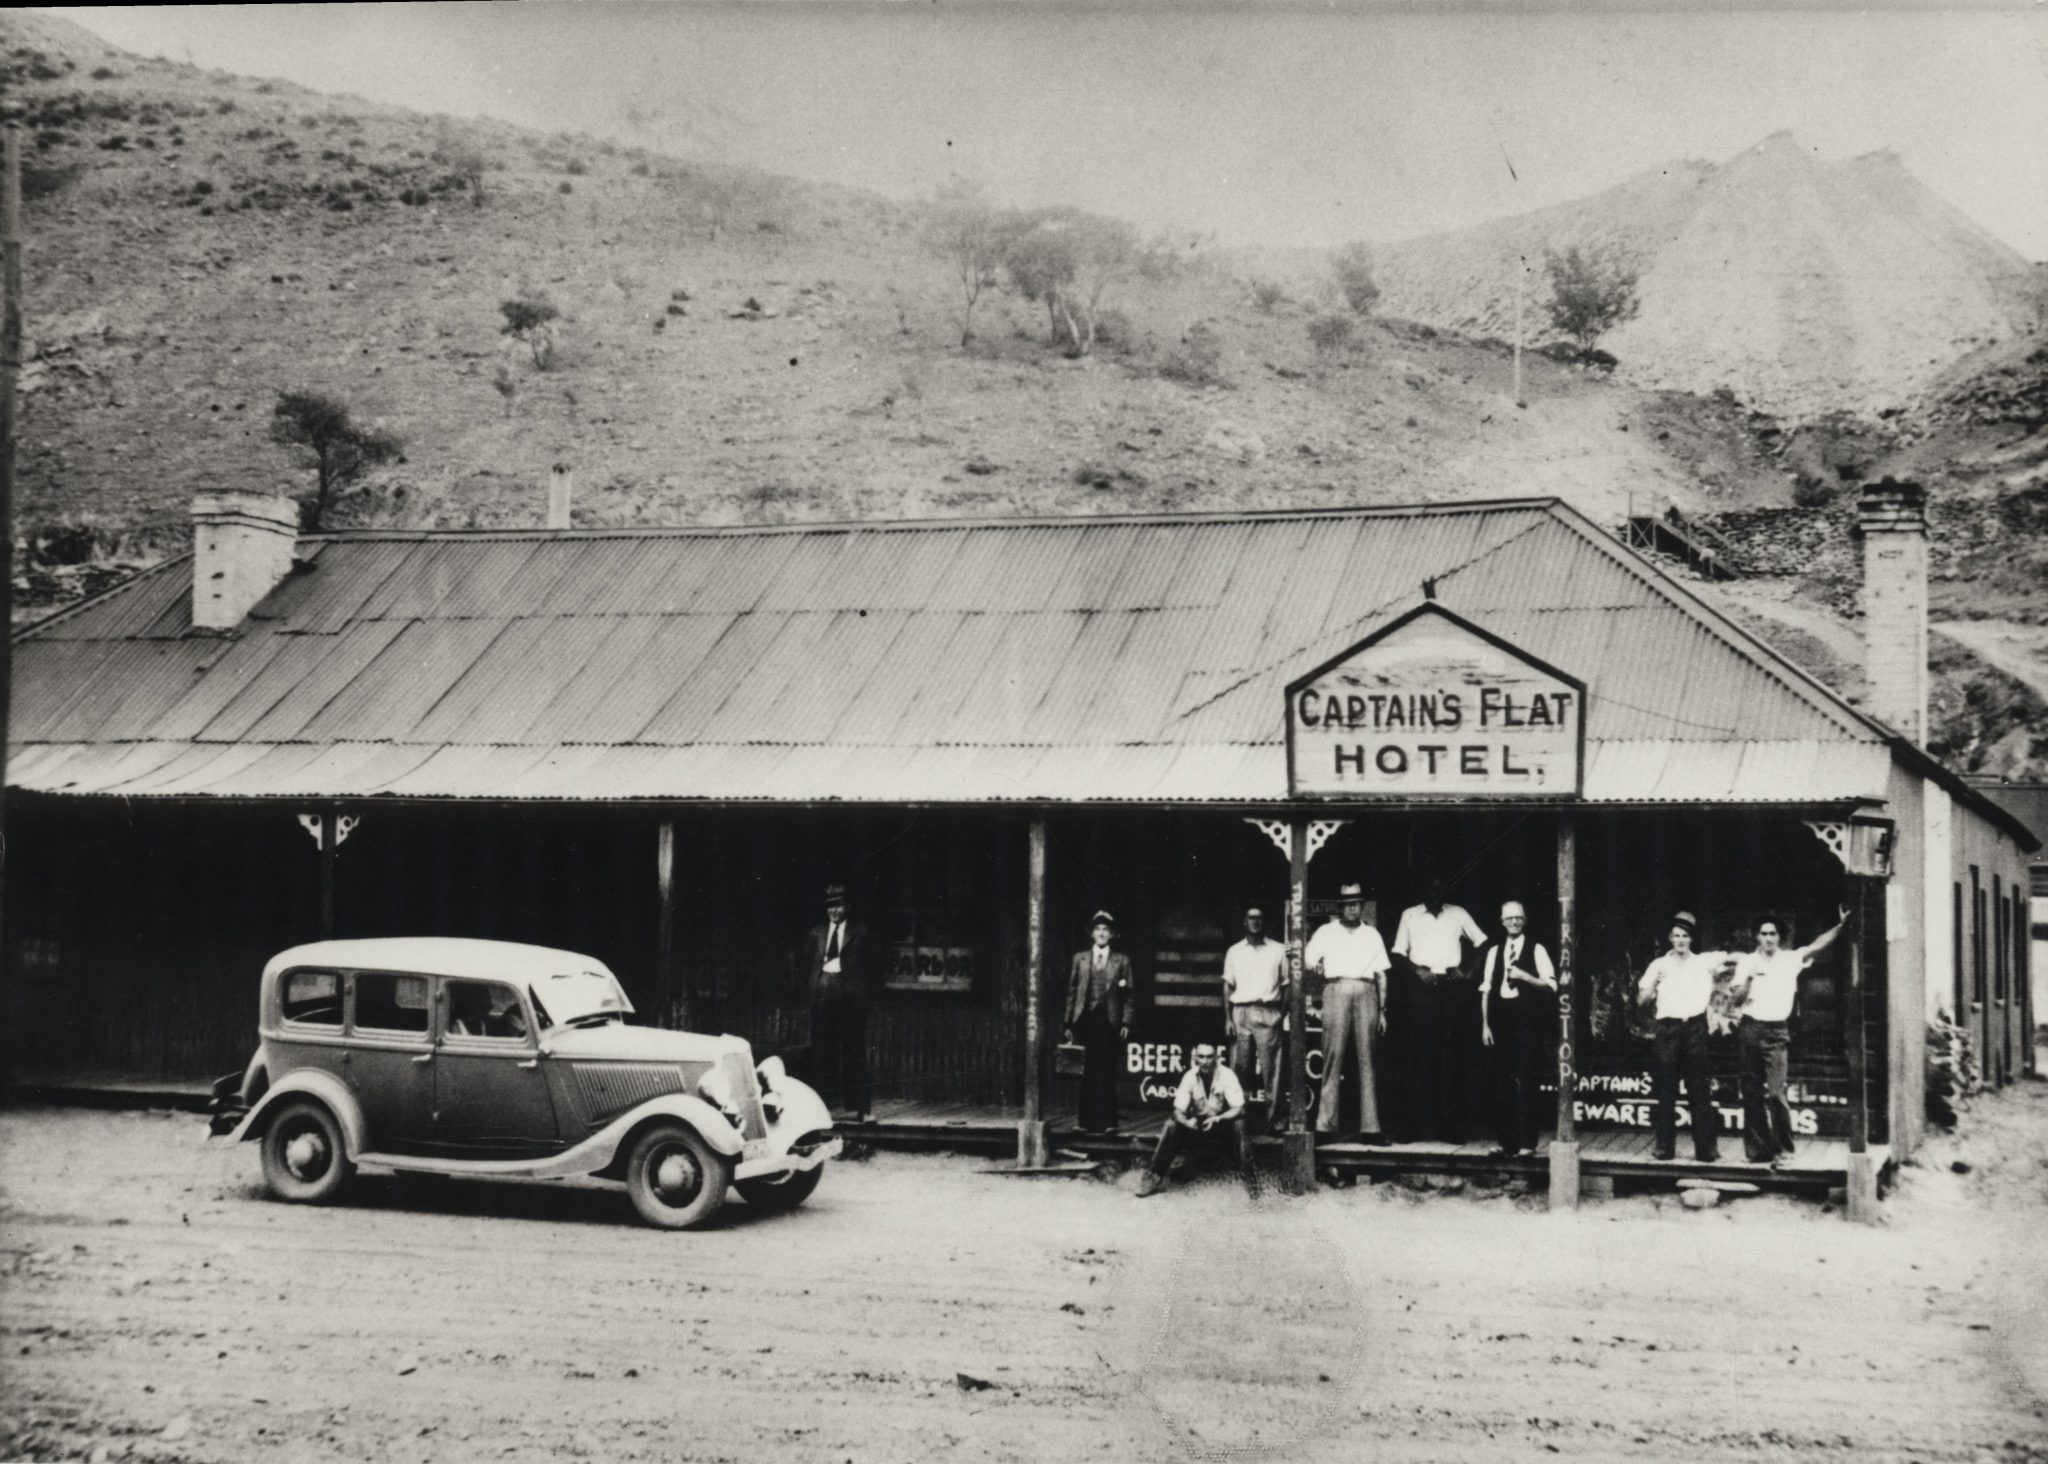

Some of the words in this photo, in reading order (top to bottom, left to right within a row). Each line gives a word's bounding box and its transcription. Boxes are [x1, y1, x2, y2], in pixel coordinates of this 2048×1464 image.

[1299, 688, 1462, 728] CAPTAIN'S
[1480, 687, 1573, 727] FLAT
[1557, 993, 1574, 1087] STOP
[1573, 1101, 1652, 1127] EWARE
